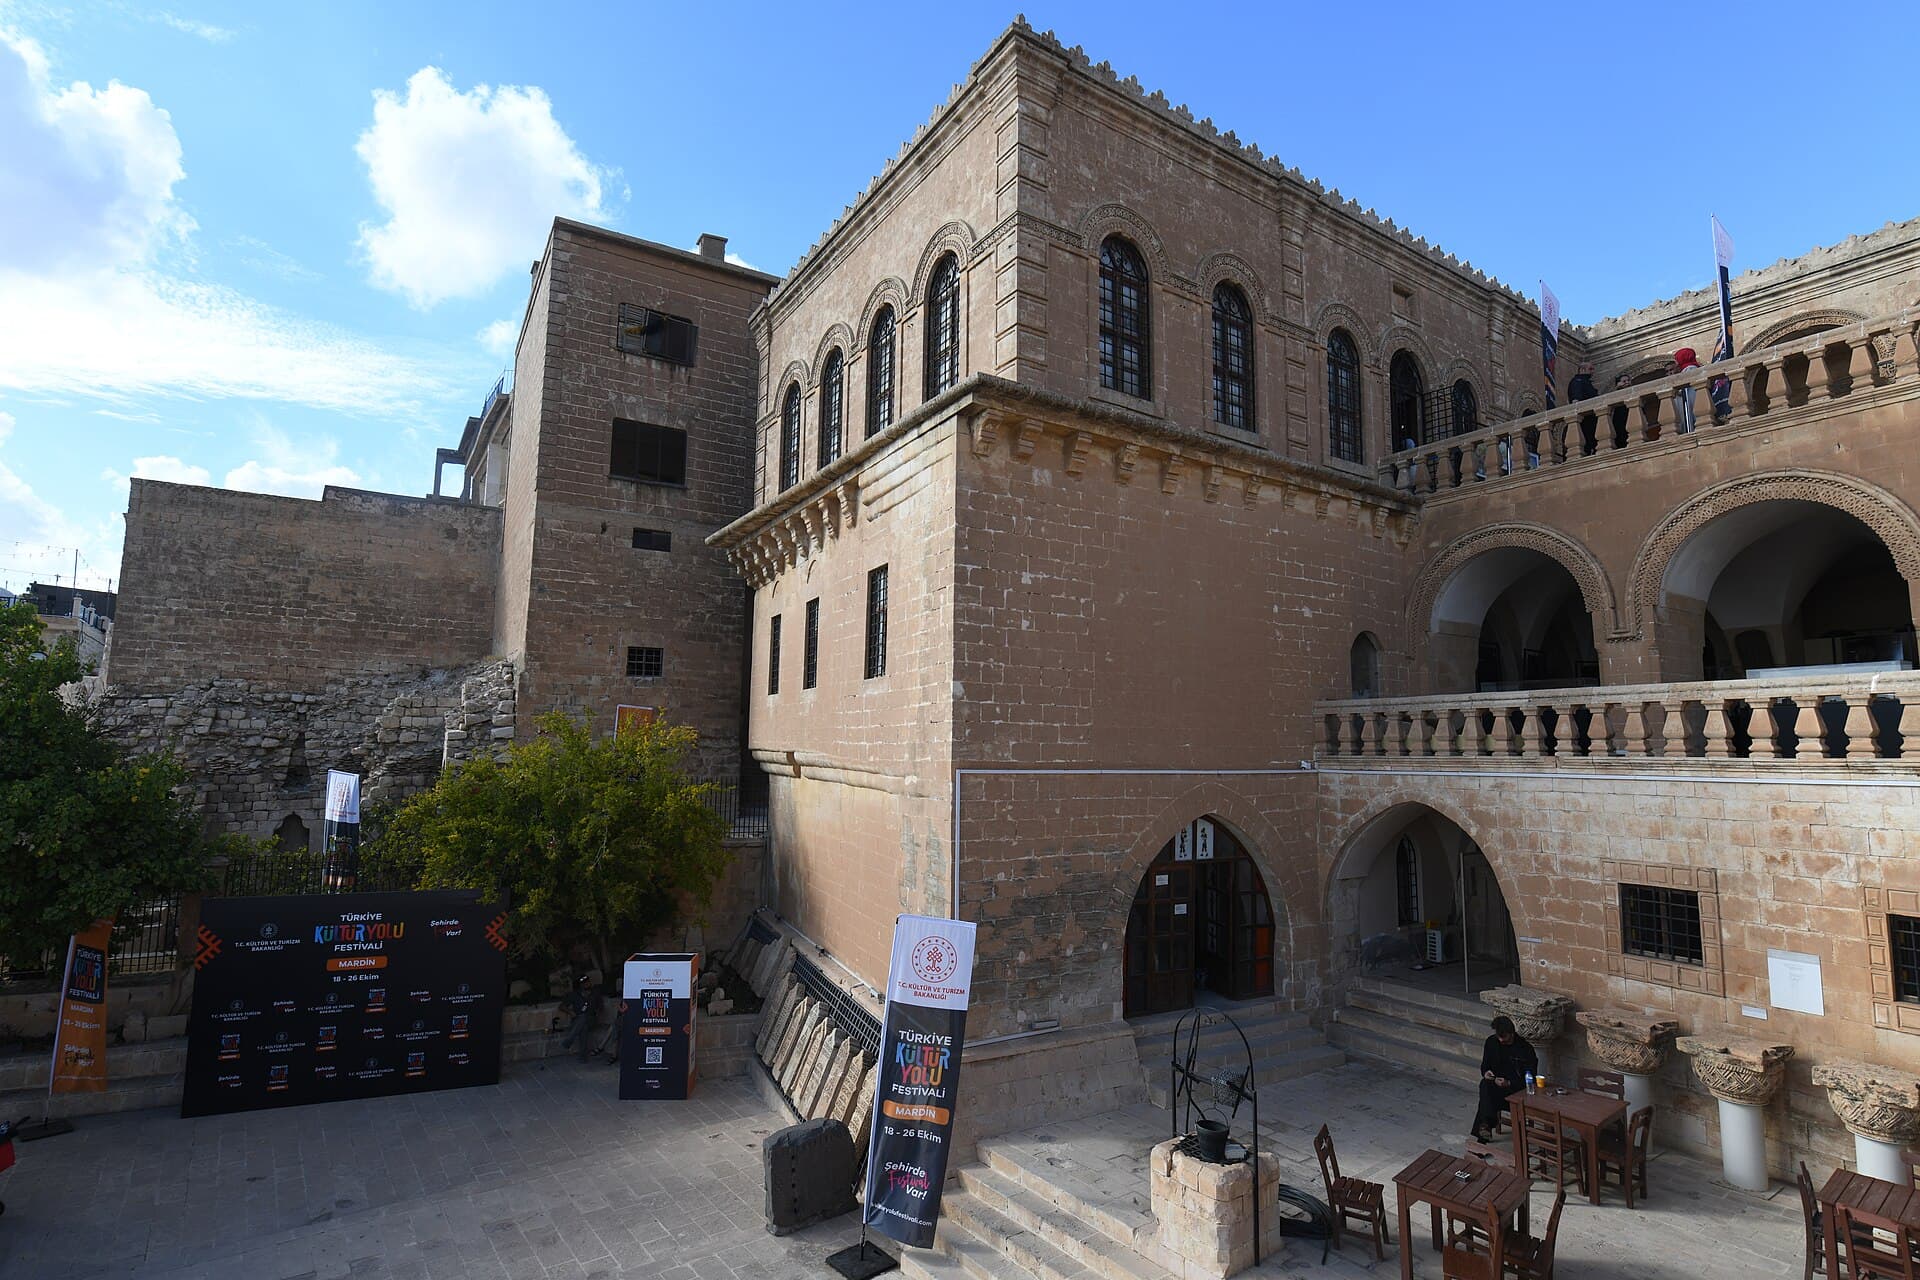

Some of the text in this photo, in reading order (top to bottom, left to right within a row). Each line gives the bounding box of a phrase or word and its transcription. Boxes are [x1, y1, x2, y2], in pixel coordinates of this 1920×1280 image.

[340, 912, 382, 922] TÜRKİYE
[314, 922, 405, 944] KÜLTÜR YOLU
[334, 941, 383, 952] FESTİVALİ
[338, 957, 376, 968] MARDİN
[908, 983, 932, 991] KÜLTÜR
[942, 987, 965, 995] TURİZM
[913, 991, 947, 1000] BAKANLIĞI
[643, 998, 669, 1009] KÜLTÜR
[646, 1007, 666, 1018] YOLU
[899, 1029, 952, 1046] TÜRKİYE
[896, 1042, 951, 1069] KÜLTÜR
[902, 1064, 943, 1086] YOLU
[892, 1083, 946, 1098] FESTİVALİ
[895, 1106, 936, 1118] MARDİN
[884, 1126, 894, 1135] 18
[903, 1129, 915, 1137] 26
[917, 1130, 942, 1143] Ekim
[884, 1161, 926, 1178] Şehirde
[888, 1170, 930, 1192] Festival
[906, 1184, 928, 1200] Var!
